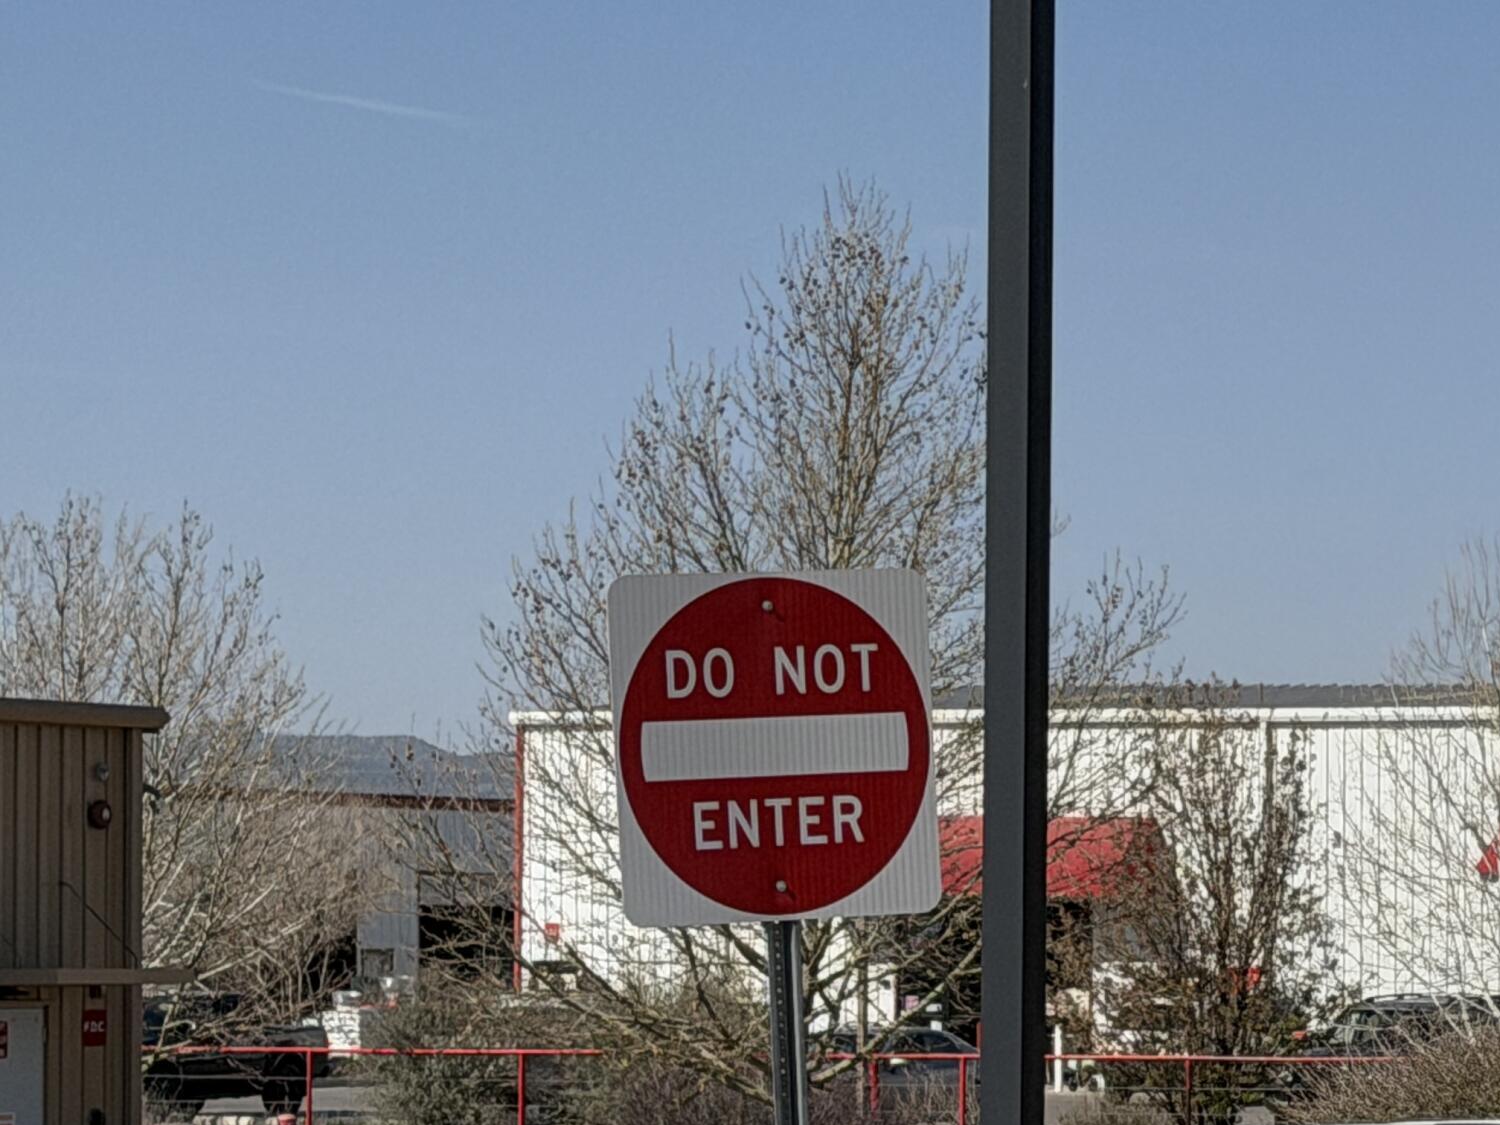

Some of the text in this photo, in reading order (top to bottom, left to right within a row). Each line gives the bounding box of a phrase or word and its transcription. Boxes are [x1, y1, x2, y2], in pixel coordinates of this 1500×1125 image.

[665, 643, 879, 699] DO NOT
[693, 795, 865, 850] ENTER
